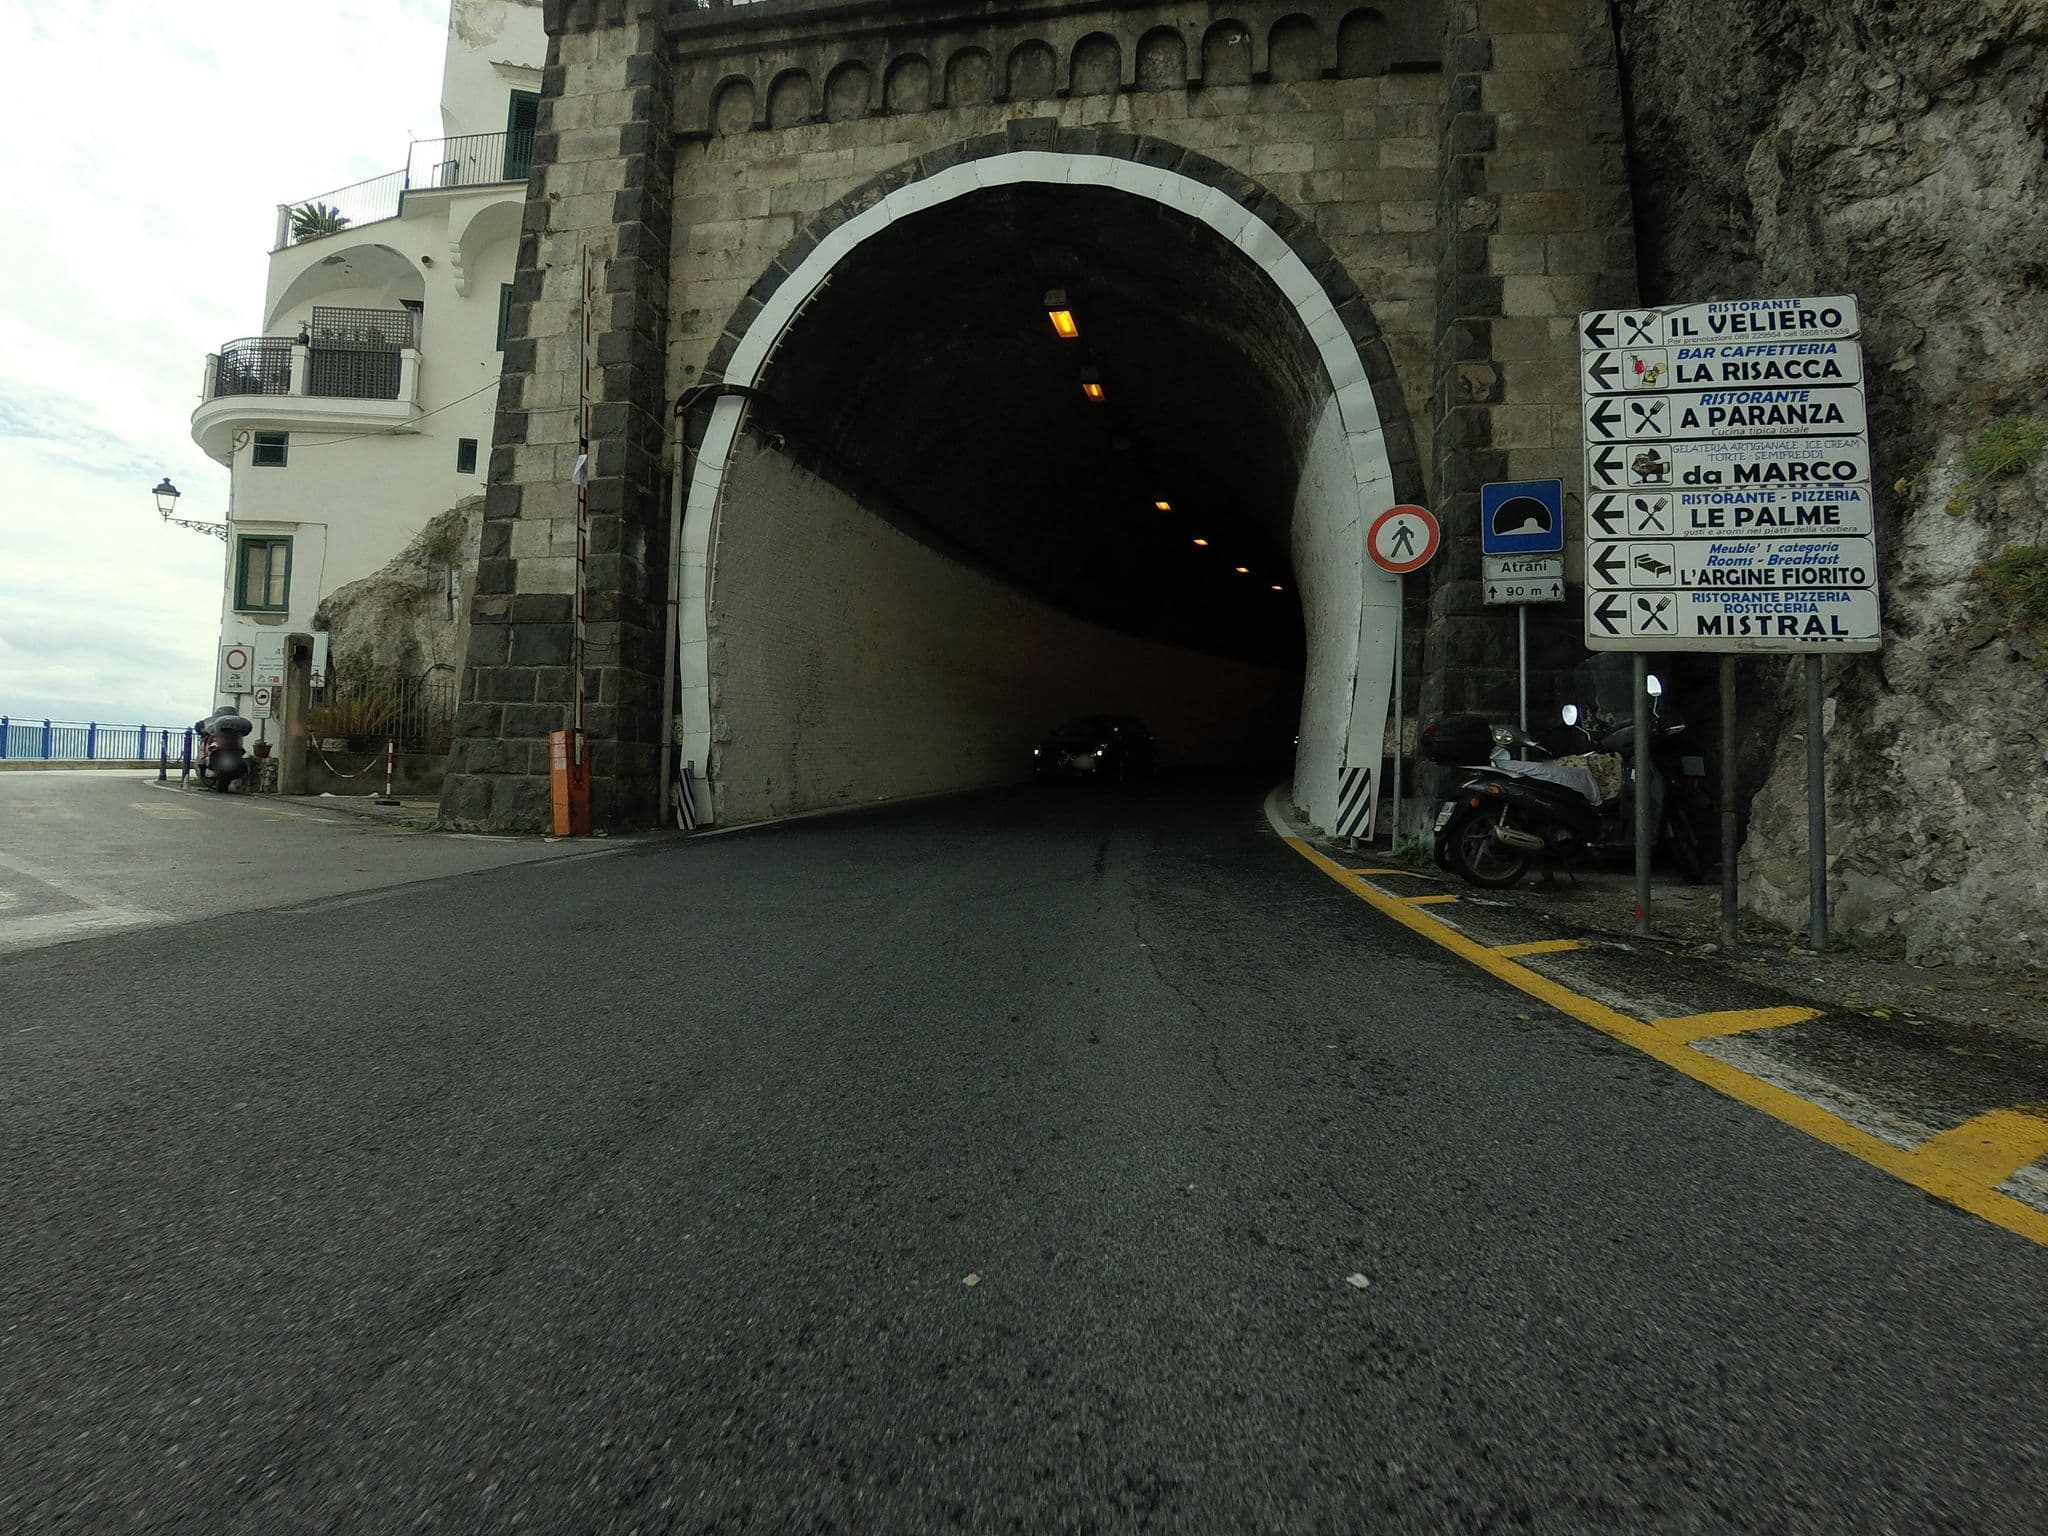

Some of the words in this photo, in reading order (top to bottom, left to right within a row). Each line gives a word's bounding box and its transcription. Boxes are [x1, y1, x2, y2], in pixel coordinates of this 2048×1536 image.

[1708, 300, 1801, 313] RISTORANTE
[1671, 317, 1698, 336] IL
[1708, 308, 1842, 333] VELIERO
[1683, 335, 1732, 345] prenotazioni
[1677, 347, 1716, 360] BAR
[1720, 343, 1838, 358] CAFFETTERIA
[1676, 363, 1713, 383] LA
[1722, 359, 1842, 381] RISACCA
[1700, 390, 1810, 406] RISTORANTE
[1680, 407, 1700, 429] A
[1708, 403, 1845, 428] PARANZA
[1711, 427, 1746, 436] Cucina
[1749, 426, 1777, 435] tipica
[1779, 425, 1810, 434] locale
[1672, 443, 1728, 454] GELATERIA
[1730, 441, 1799, 451] ARTIGIANALE
[1805, 440, 1822, 450] ICE
[1824, 439, 1860, 449] CREAM
[1708, 453, 1747, 462] TORTE
[1754, 450, 1825, 461] SEMIFREDDI
[1683, 465, 1722, 485] da
[1733, 461, 1857, 484] MARCO
[1681, 491, 1776, 505] RISTORANTE
[1791, 490, 1861, 502] PIZZERIA
[1691, 508, 1725, 528] LE
[1734, 505, 1840, 527] PALME
[1683, 529, 1705, 537] gusti
[1764, 527, 1790, 536] piatti
[1793, 526, 1817, 534] della
[1819, 525, 1858, 533] Costiera
[1709, 543, 1761, 554] Meuble'
[1766, 543, 1772, 553] 1
[1778, 541, 1840, 555] categoria
[1501, 560, 1547, 573] Atrani
[1706, 555, 1753, 567] Rooms
[1767, 553, 1840, 566] Breakfast
[1680, 568, 1776, 585] L'ARGINE
[1782, 567, 1866, 585] FIORITO
[1506, 586, 1525, 596] 90
[1530, 588, 1542, 596] m
[1692, 592, 1779, 603] RISTORANTE
[1784, 591, 1851, 602] PIZZERIA
[1723, 603, 1819, 614] ROSTICCERIA
[1697, 615, 1849, 636] MISTRAL
